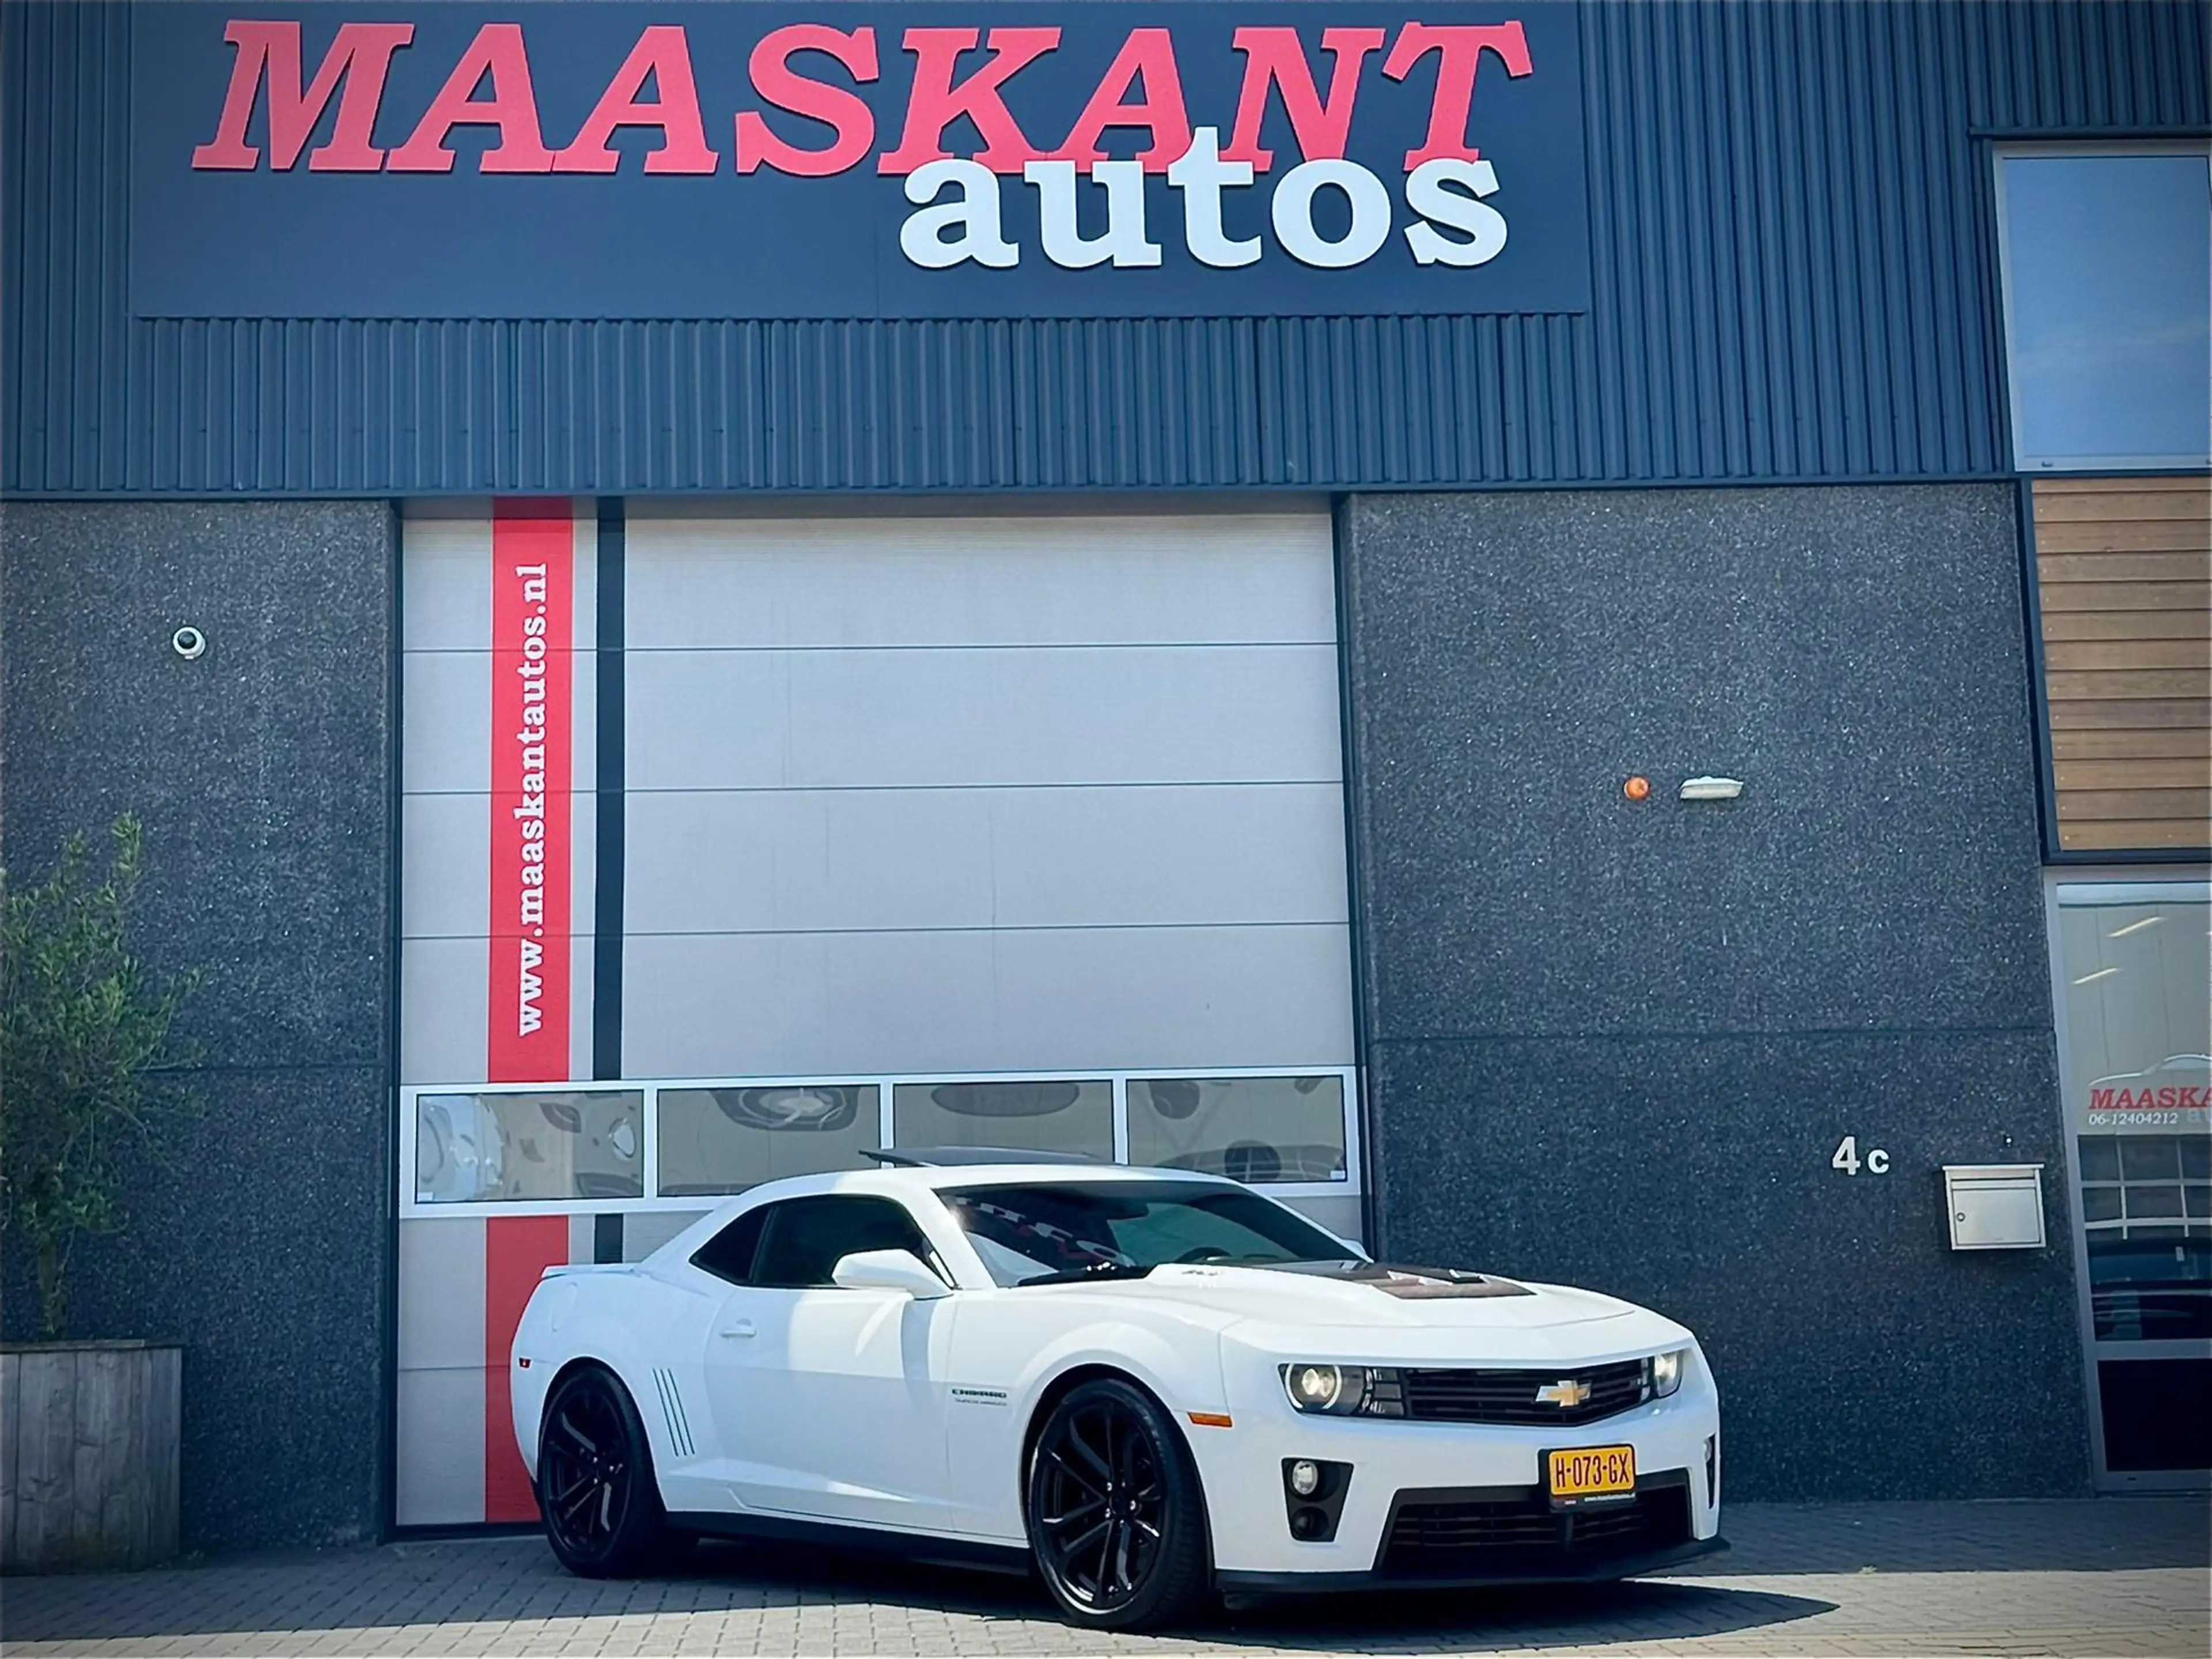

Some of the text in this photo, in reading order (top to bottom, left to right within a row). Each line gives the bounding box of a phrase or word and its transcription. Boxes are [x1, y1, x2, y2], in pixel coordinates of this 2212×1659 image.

[191, 20, 1533, 175] MAASKANT
[899, 126, 1509, 268] autos
[514, 563, 547, 1036] www.maaskantautos.nl
[2088, 1112, 2178, 1125] 06-12404212
[1556, 1453, 1630, 1488] H-073-GX
